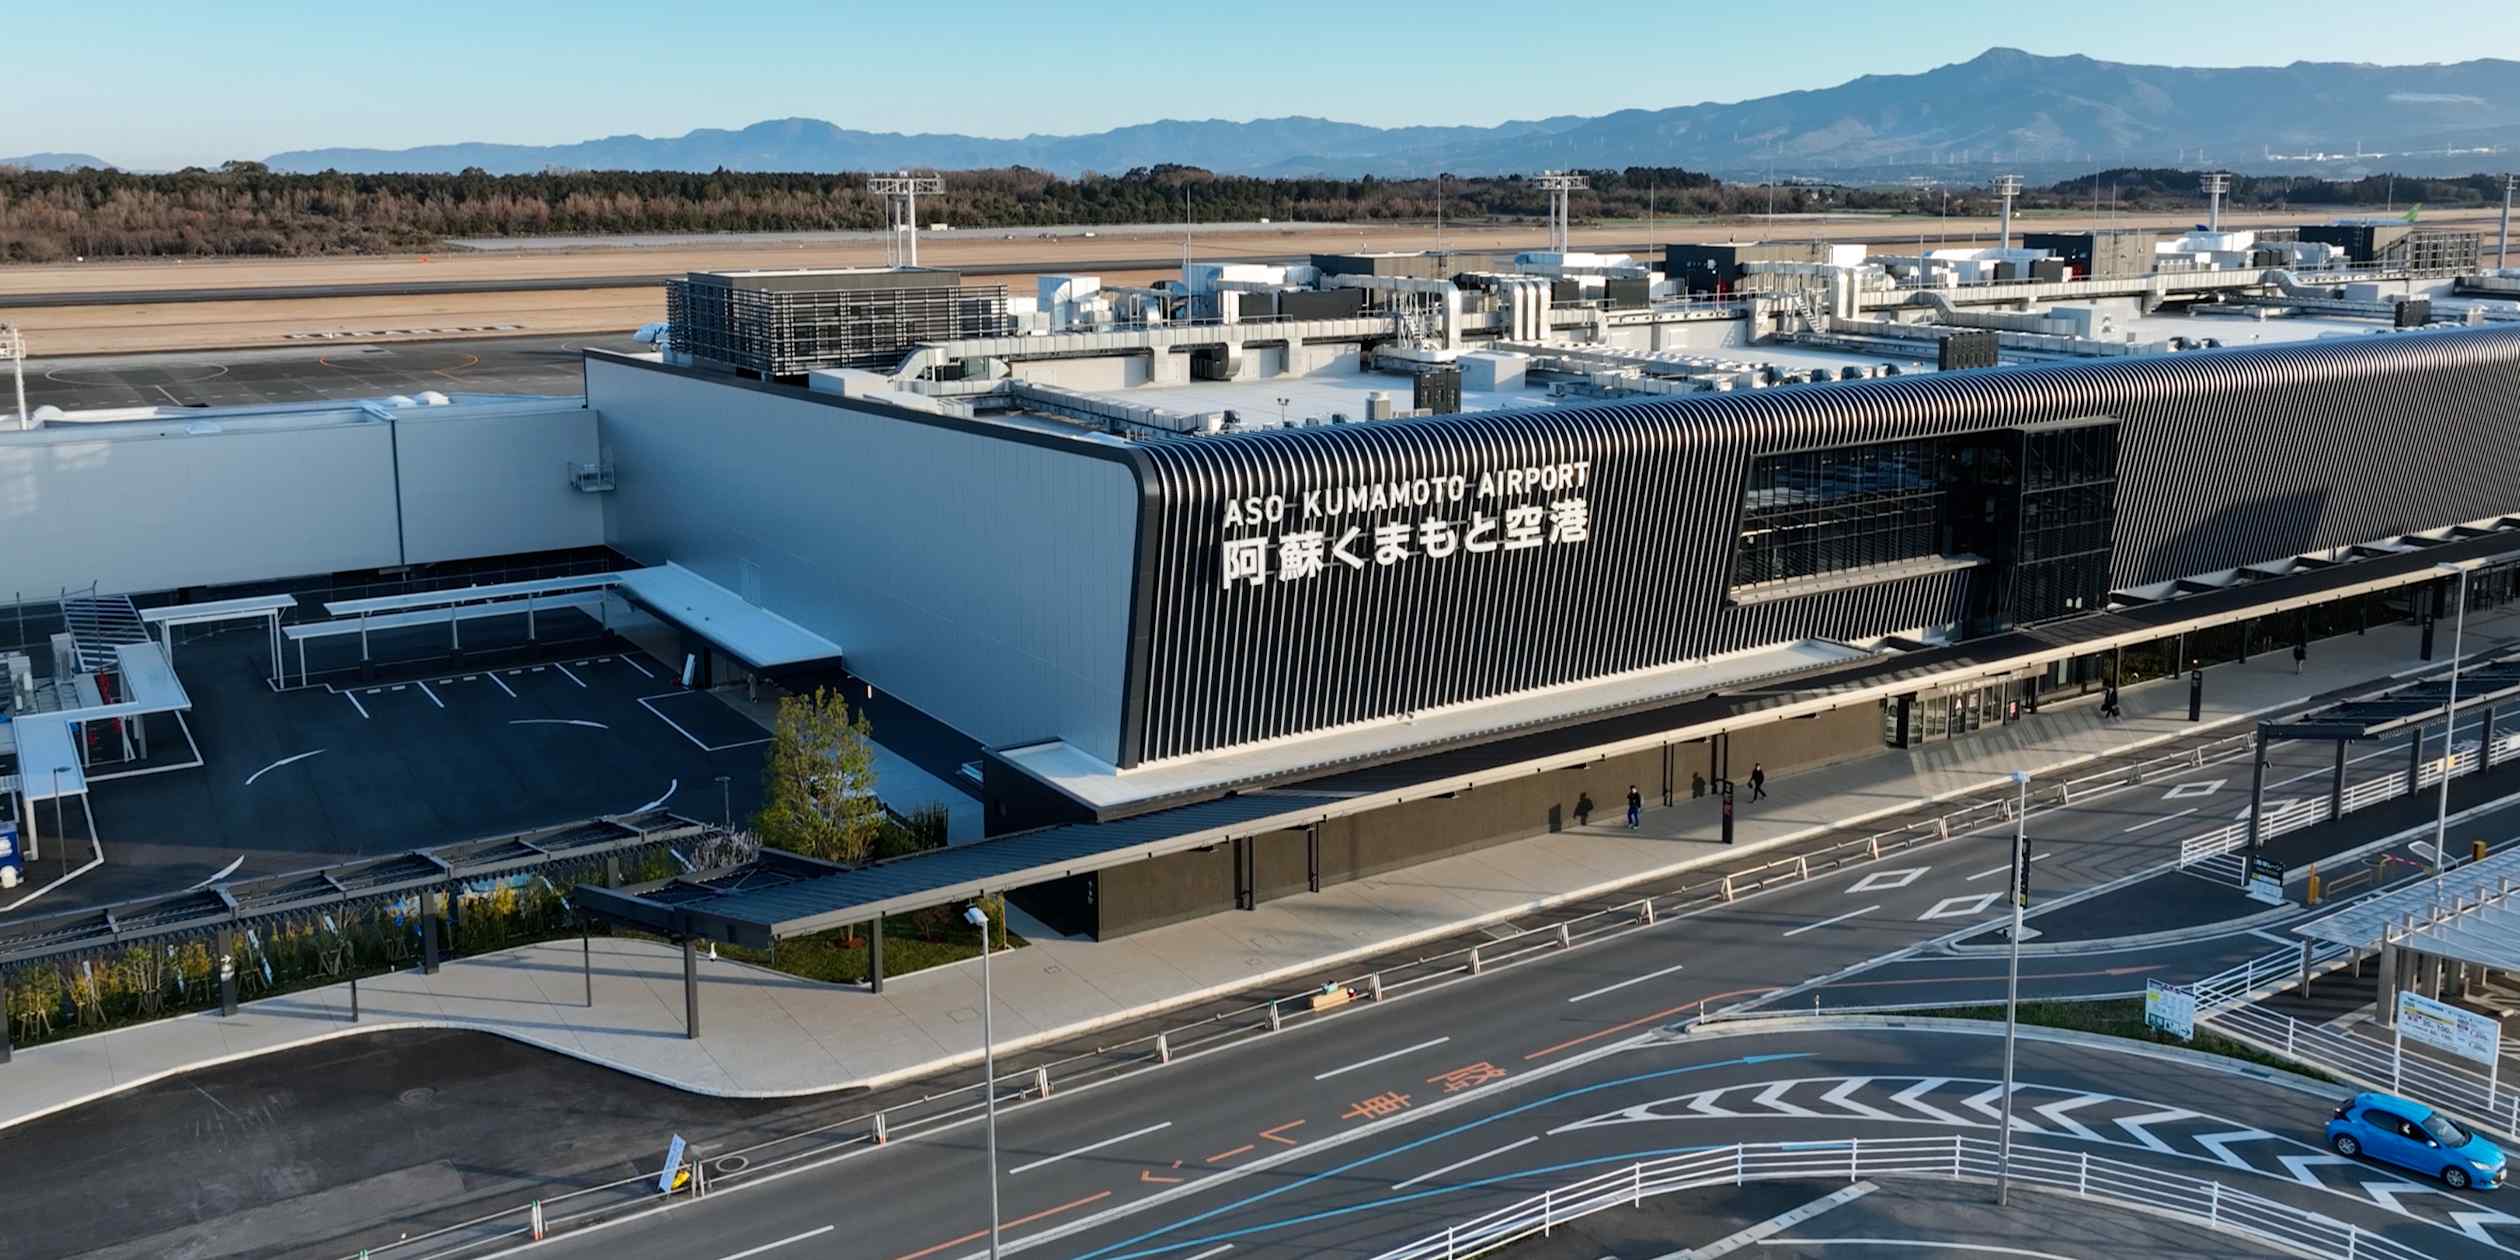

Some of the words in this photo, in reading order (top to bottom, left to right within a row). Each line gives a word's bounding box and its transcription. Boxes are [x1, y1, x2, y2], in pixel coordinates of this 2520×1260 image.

[1223, 494, 1285, 528] ASO
[1303, 473, 1465, 521] KUMAMOTO
[1477, 461, 1590, 499] AIRPORT
[1222, 497, 1590, 590] 阿蘇くまもと空港
